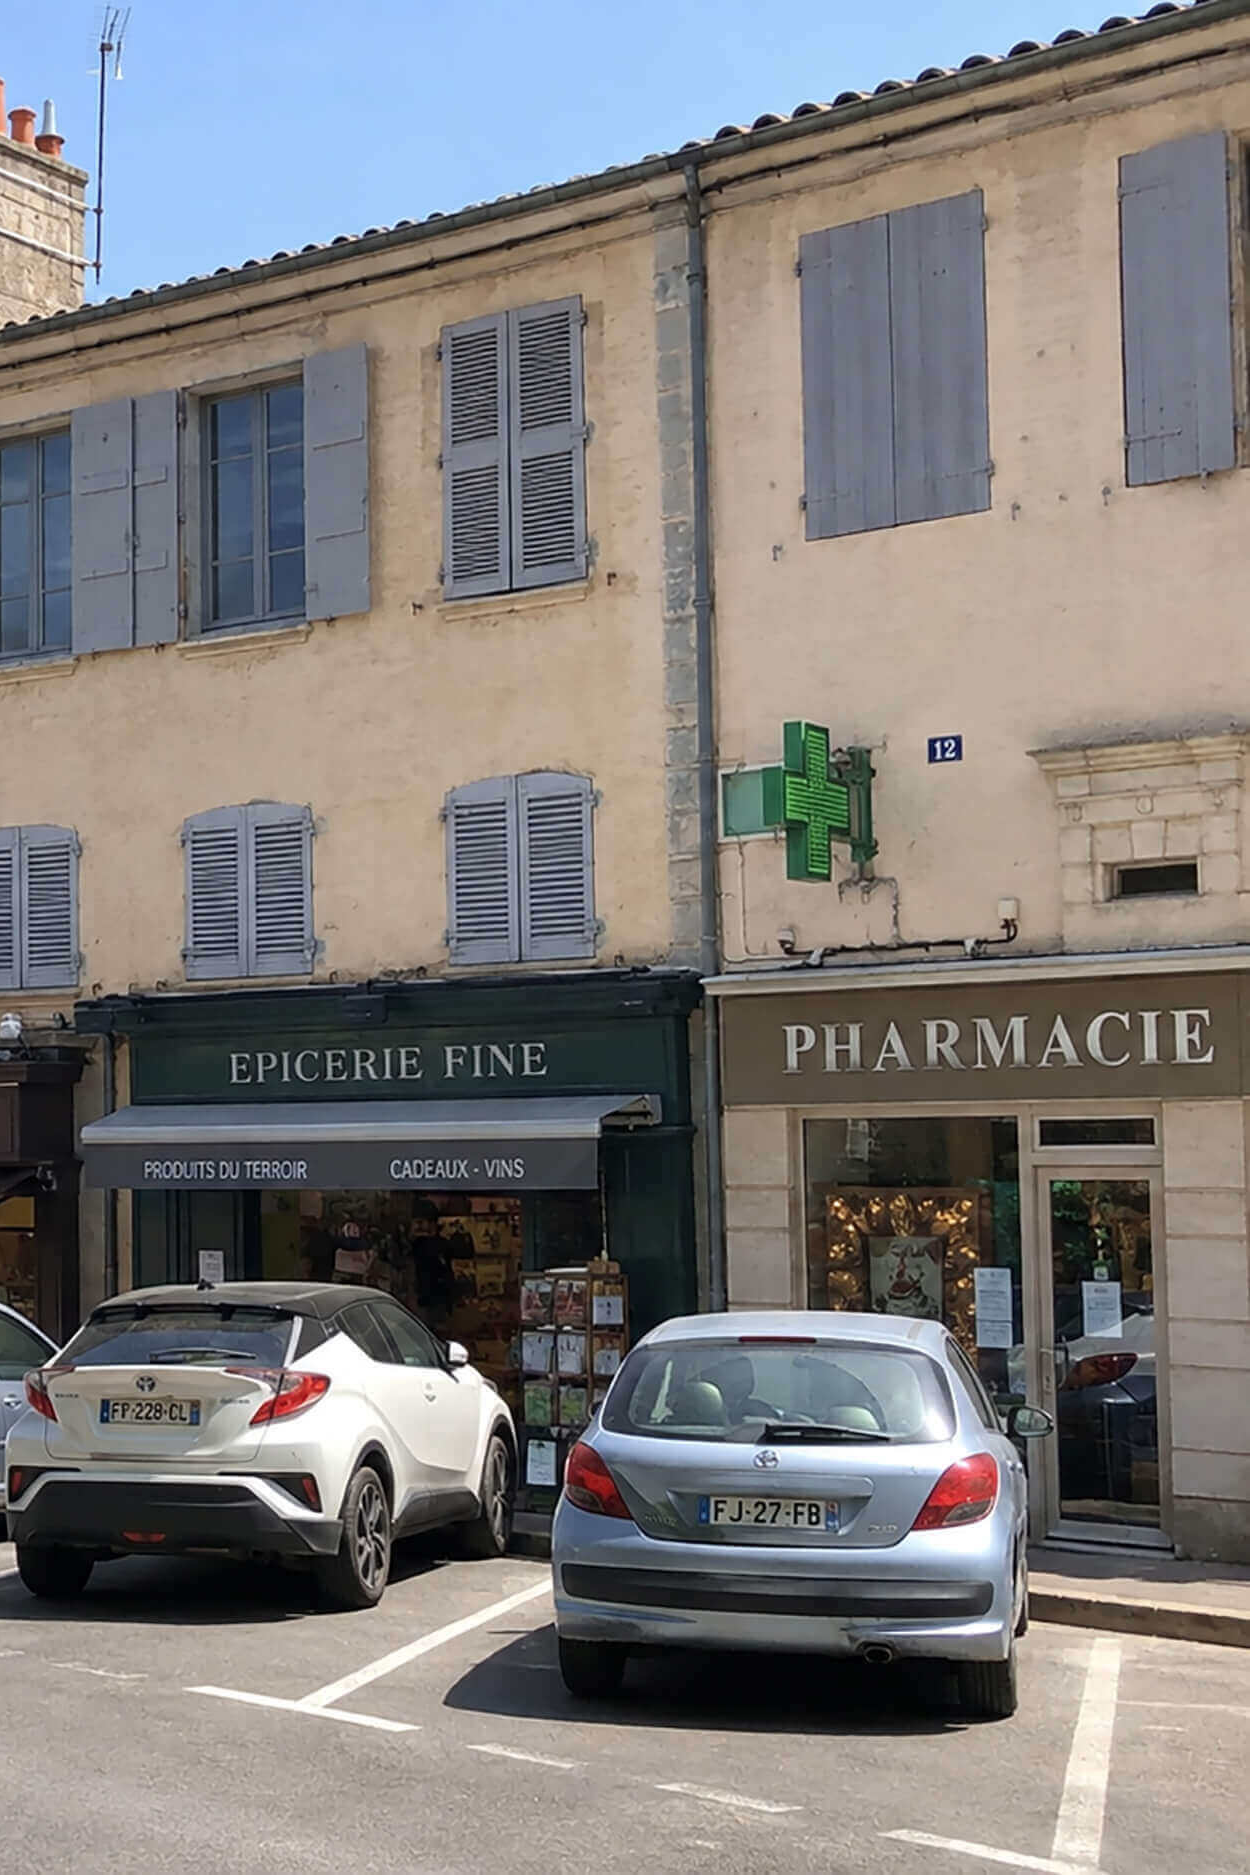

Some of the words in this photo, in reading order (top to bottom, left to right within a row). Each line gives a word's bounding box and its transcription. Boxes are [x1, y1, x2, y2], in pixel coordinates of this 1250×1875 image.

[933, 739, 956, 760] 12
[781, 1008, 1215, 1074] PHARMACIE
[229, 1047, 423, 1084] EPICERIE
[444, 1042, 548, 1078] FINE
[144, 1161, 215, 1179] PRODUITS
[219, 1161, 240, 1179] DU
[244, 1161, 307, 1179] TERROIR
[390, 1159, 469, 1179] CADEAUX
[484, 1158, 524, 1178] VINS
[713, 1500, 821, 1525] FJ-27-FB
